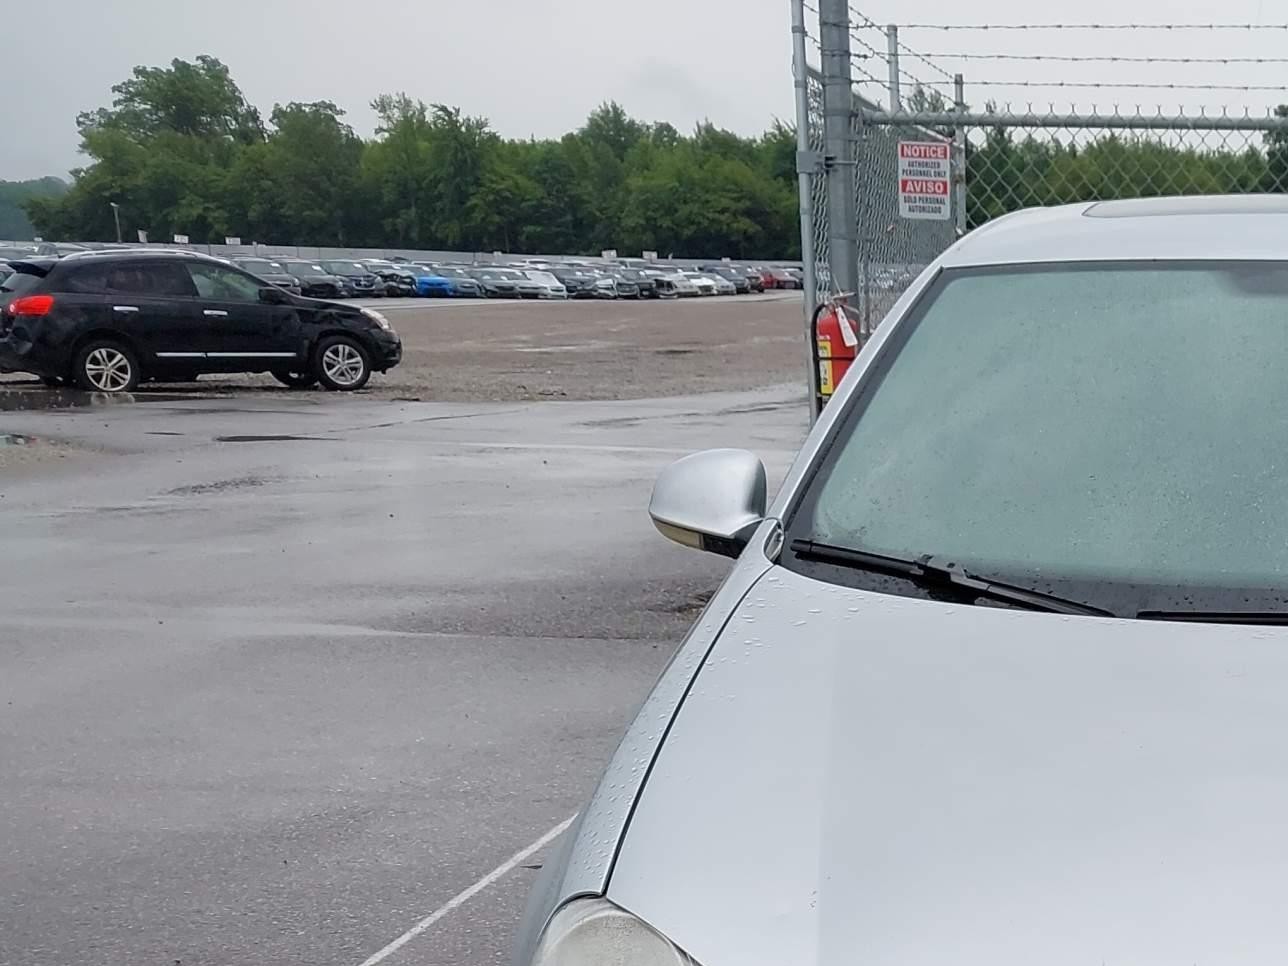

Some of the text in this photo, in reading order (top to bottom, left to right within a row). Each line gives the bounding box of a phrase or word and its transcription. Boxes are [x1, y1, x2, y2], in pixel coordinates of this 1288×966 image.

[903, 145, 945, 158] NOTICE
[907, 160, 941, 168] AUTHORIZED
[902, 168, 947, 178] PERSONNEL ONLY
[905, 180, 944, 193] AVISO
[918, 196, 946, 205] PERSONAL
[908, 205, 942, 214] AUTORIZADO
